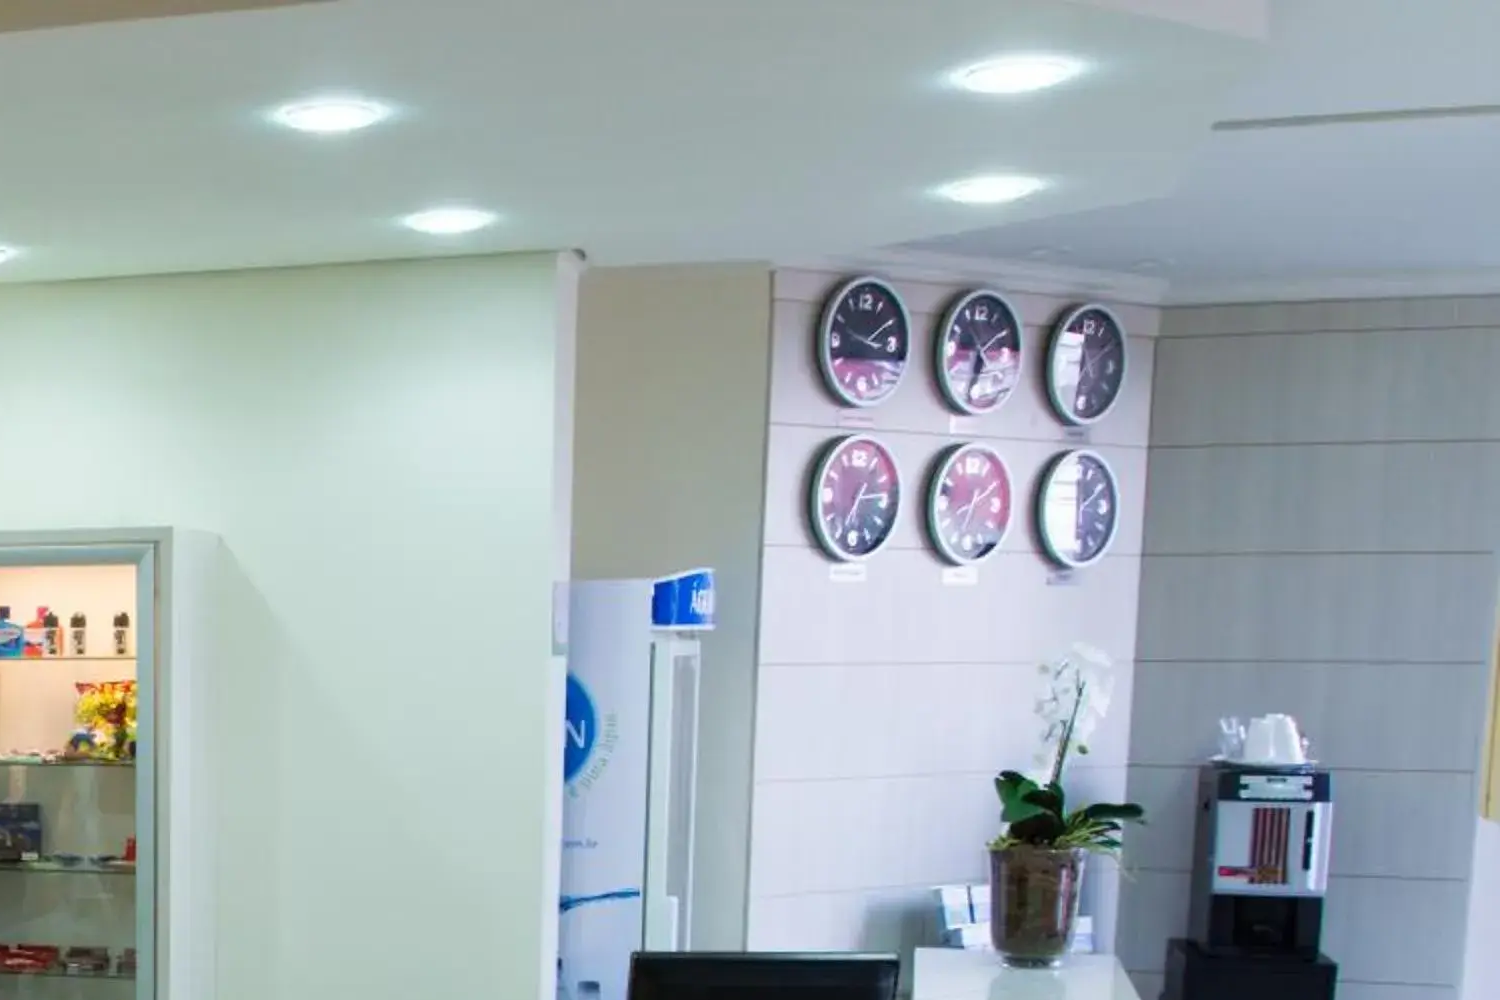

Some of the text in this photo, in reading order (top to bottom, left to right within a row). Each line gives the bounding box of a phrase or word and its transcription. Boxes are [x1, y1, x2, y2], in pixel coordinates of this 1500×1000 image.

[859, 293, 873, 310] 12
[974, 304, 988, 320] 12
[851, 449, 867, 467] 12
[965, 457, 979, 474] 12
